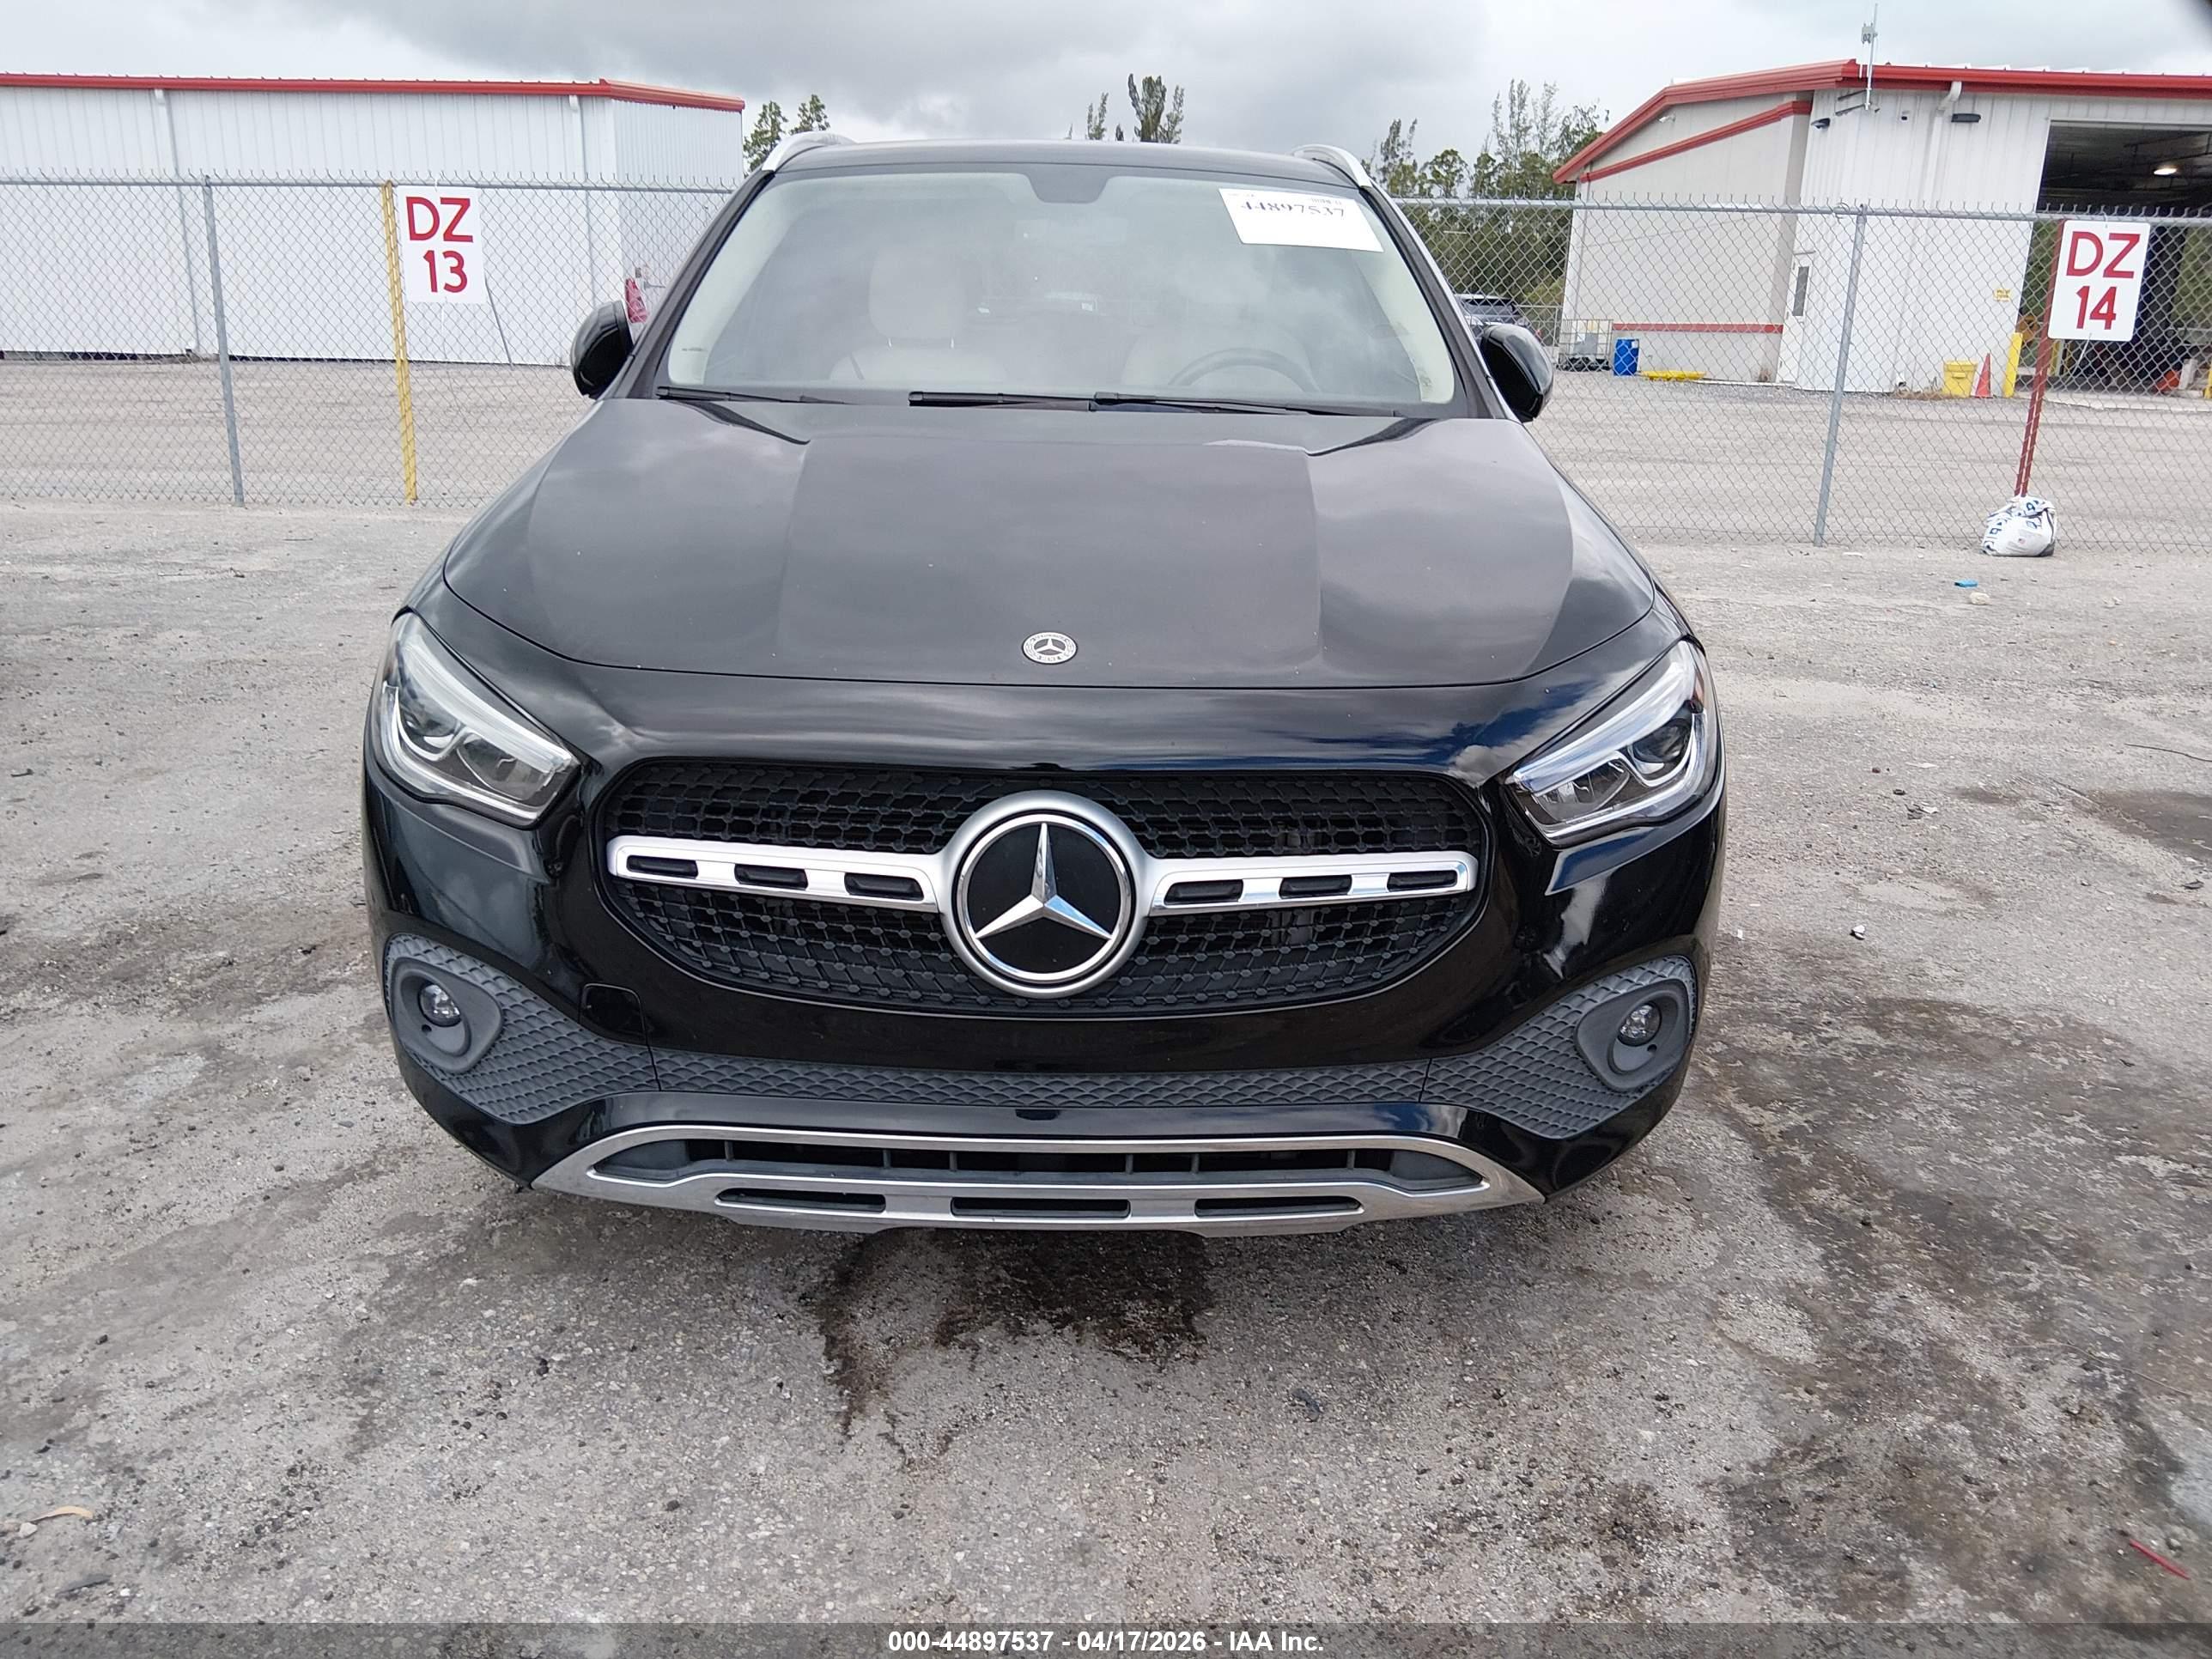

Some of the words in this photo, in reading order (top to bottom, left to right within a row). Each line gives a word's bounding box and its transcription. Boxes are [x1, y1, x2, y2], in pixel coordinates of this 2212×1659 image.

[406, 197, 473, 243] DZ
[423, 251, 468, 294] 13
[2066, 232, 2140, 278] DZ
[2076, 286, 2117, 330] 14
